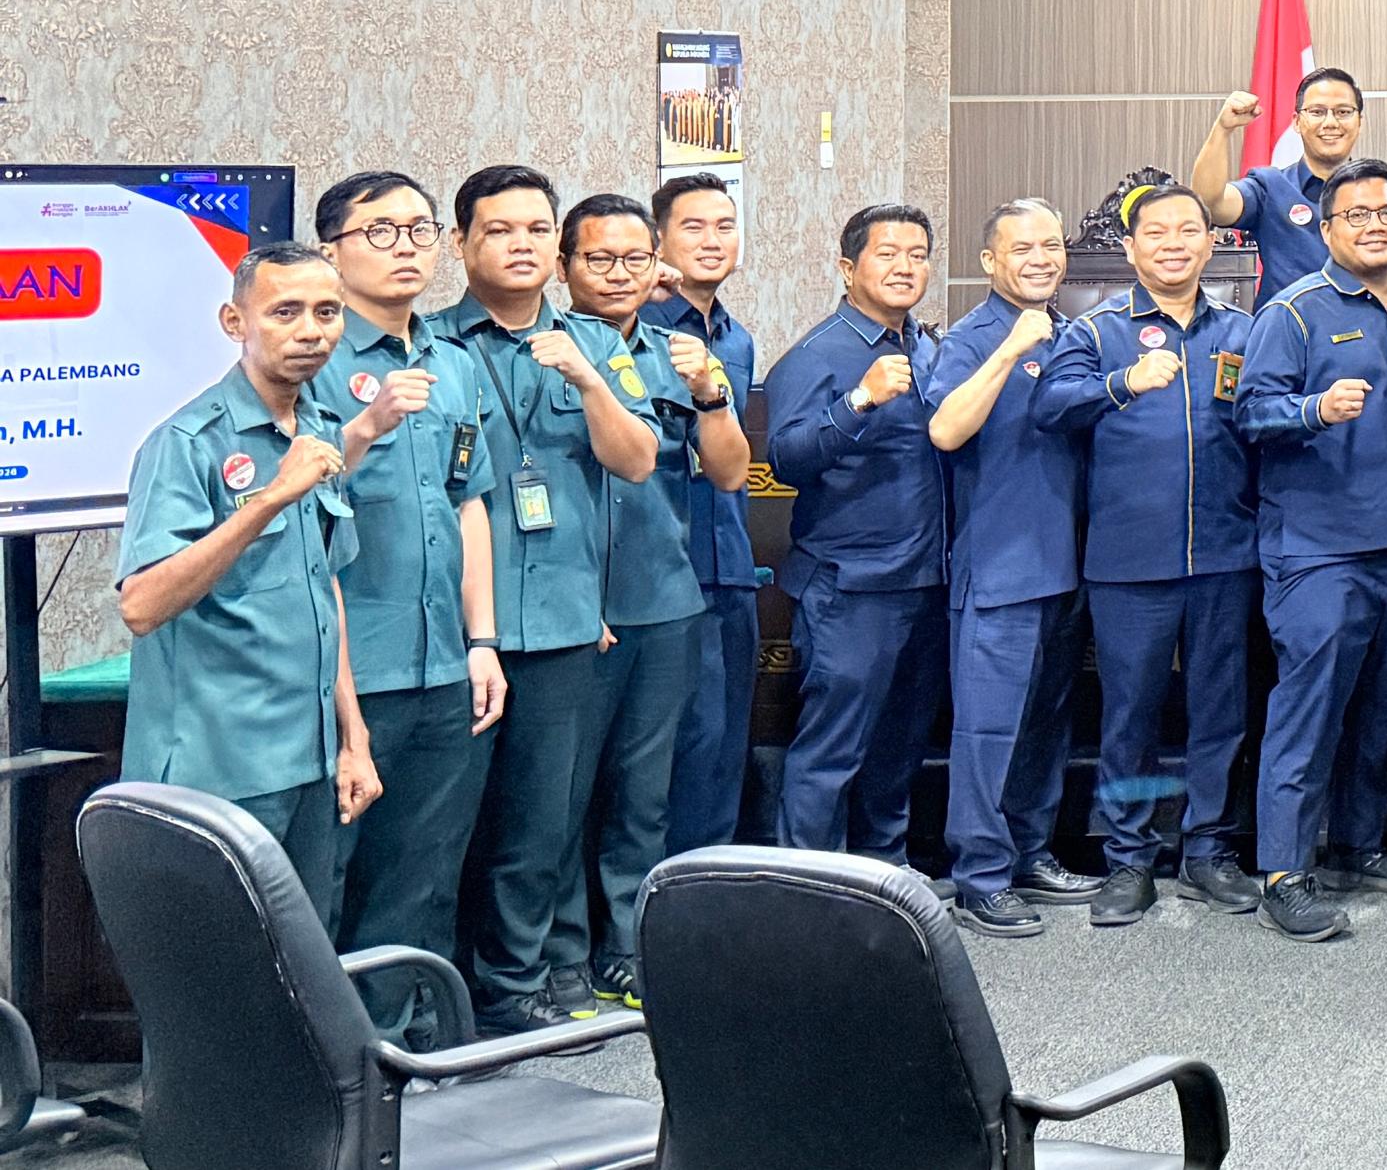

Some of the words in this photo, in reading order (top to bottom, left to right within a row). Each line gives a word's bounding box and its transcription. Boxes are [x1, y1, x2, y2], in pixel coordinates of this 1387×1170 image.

[0, 264, 82, 299] AN
[20, 363, 140, 382] PALEMBANG
[22, 418, 82, 439] M.H.
